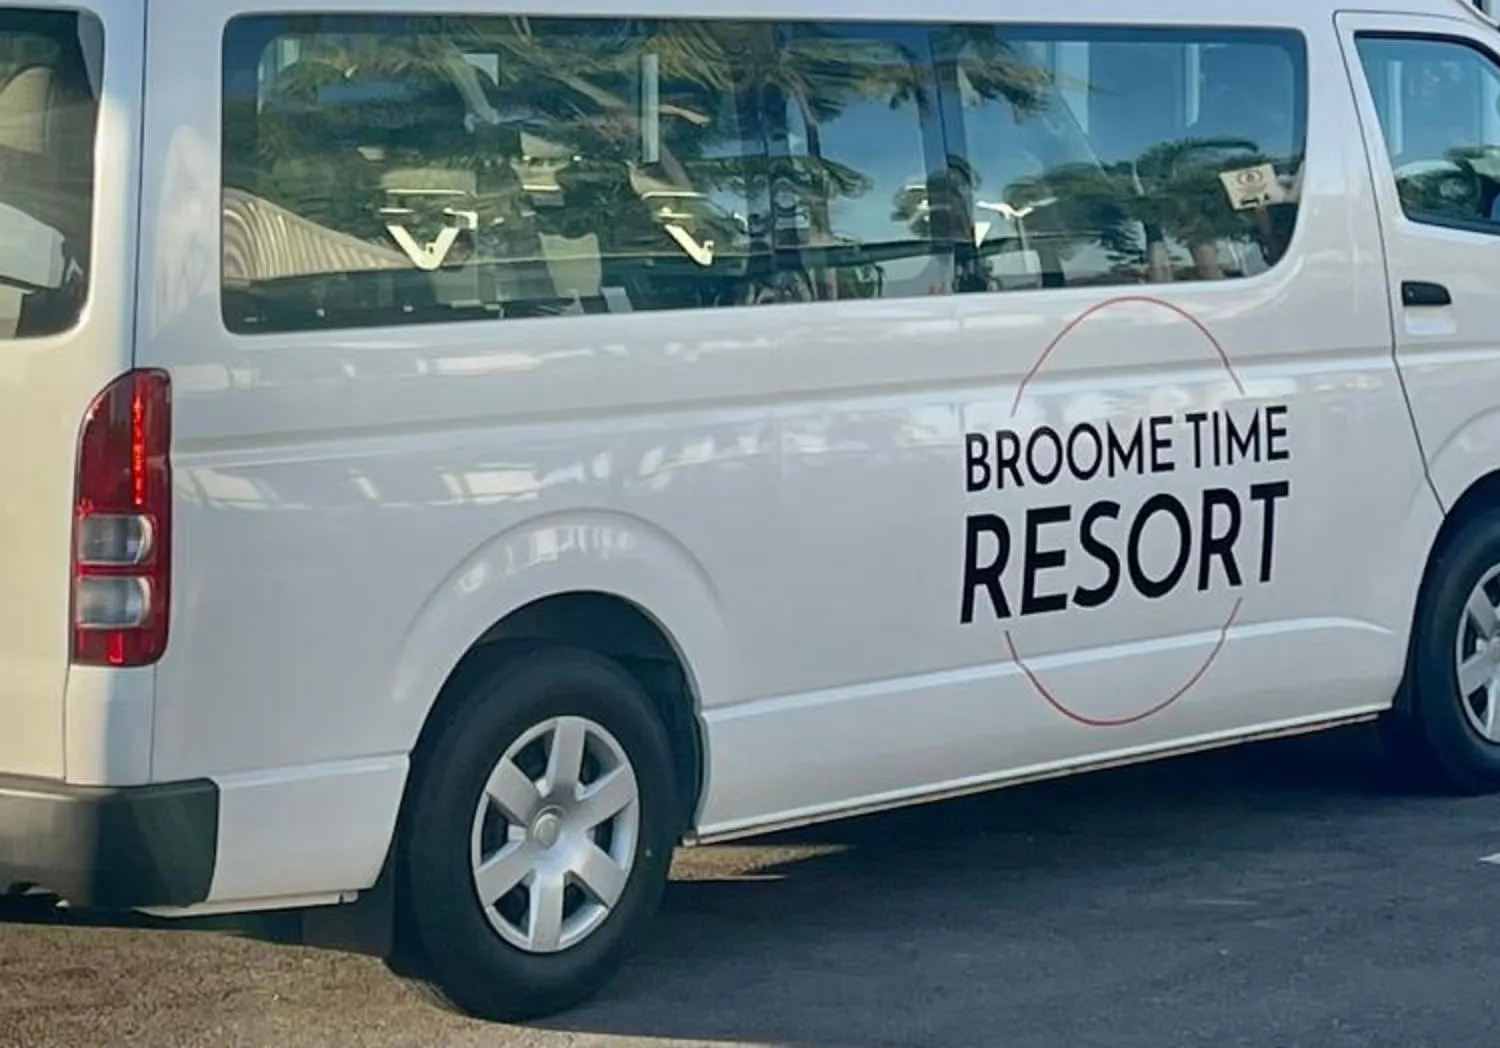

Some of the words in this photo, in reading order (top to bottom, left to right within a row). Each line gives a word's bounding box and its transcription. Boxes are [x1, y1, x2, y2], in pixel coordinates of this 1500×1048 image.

[964, 415, 1175, 492] BROOME
[1186, 405, 1291, 468] TIME
[959, 480, 1291, 624] RESORT
